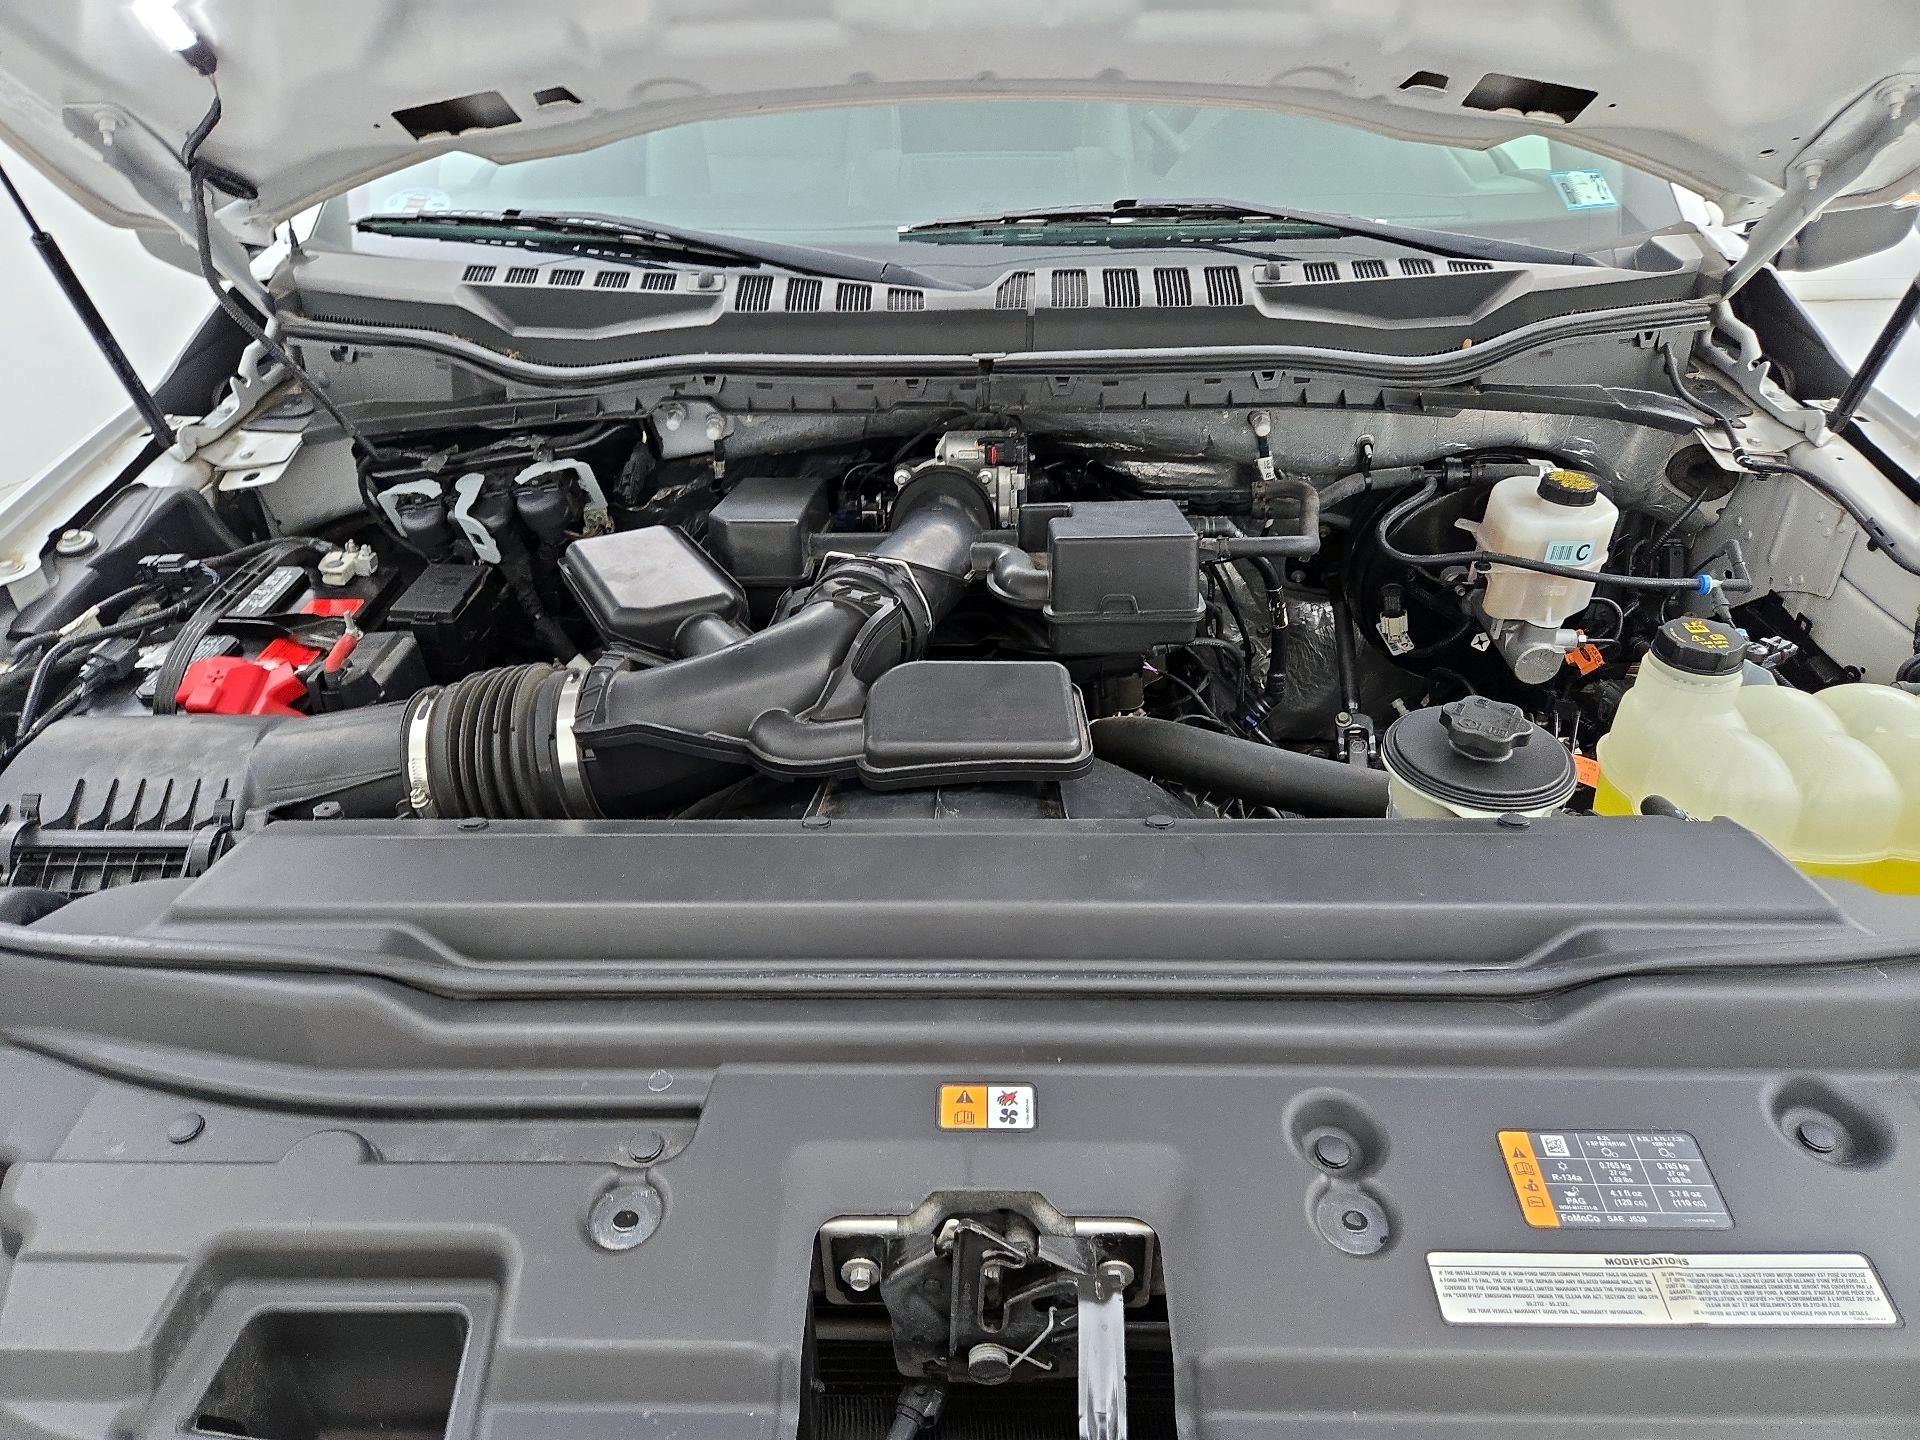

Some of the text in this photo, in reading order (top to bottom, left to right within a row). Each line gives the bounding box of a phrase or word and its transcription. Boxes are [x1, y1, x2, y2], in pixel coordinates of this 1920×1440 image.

[1576, 544, 1590, 561] C
[1620, 1162, 1632, 1172] kg
[1678, 1163, 1690, 1172] kg
[1614, 1199, 1647, 1208] (120 cc)
[1672, 1200, 1707, 1208] (110 cc)
[1560, 1214, 1600, 1222] FoMoCo
[1605, 1257, 1689, 1266] MODIFICATIONS
